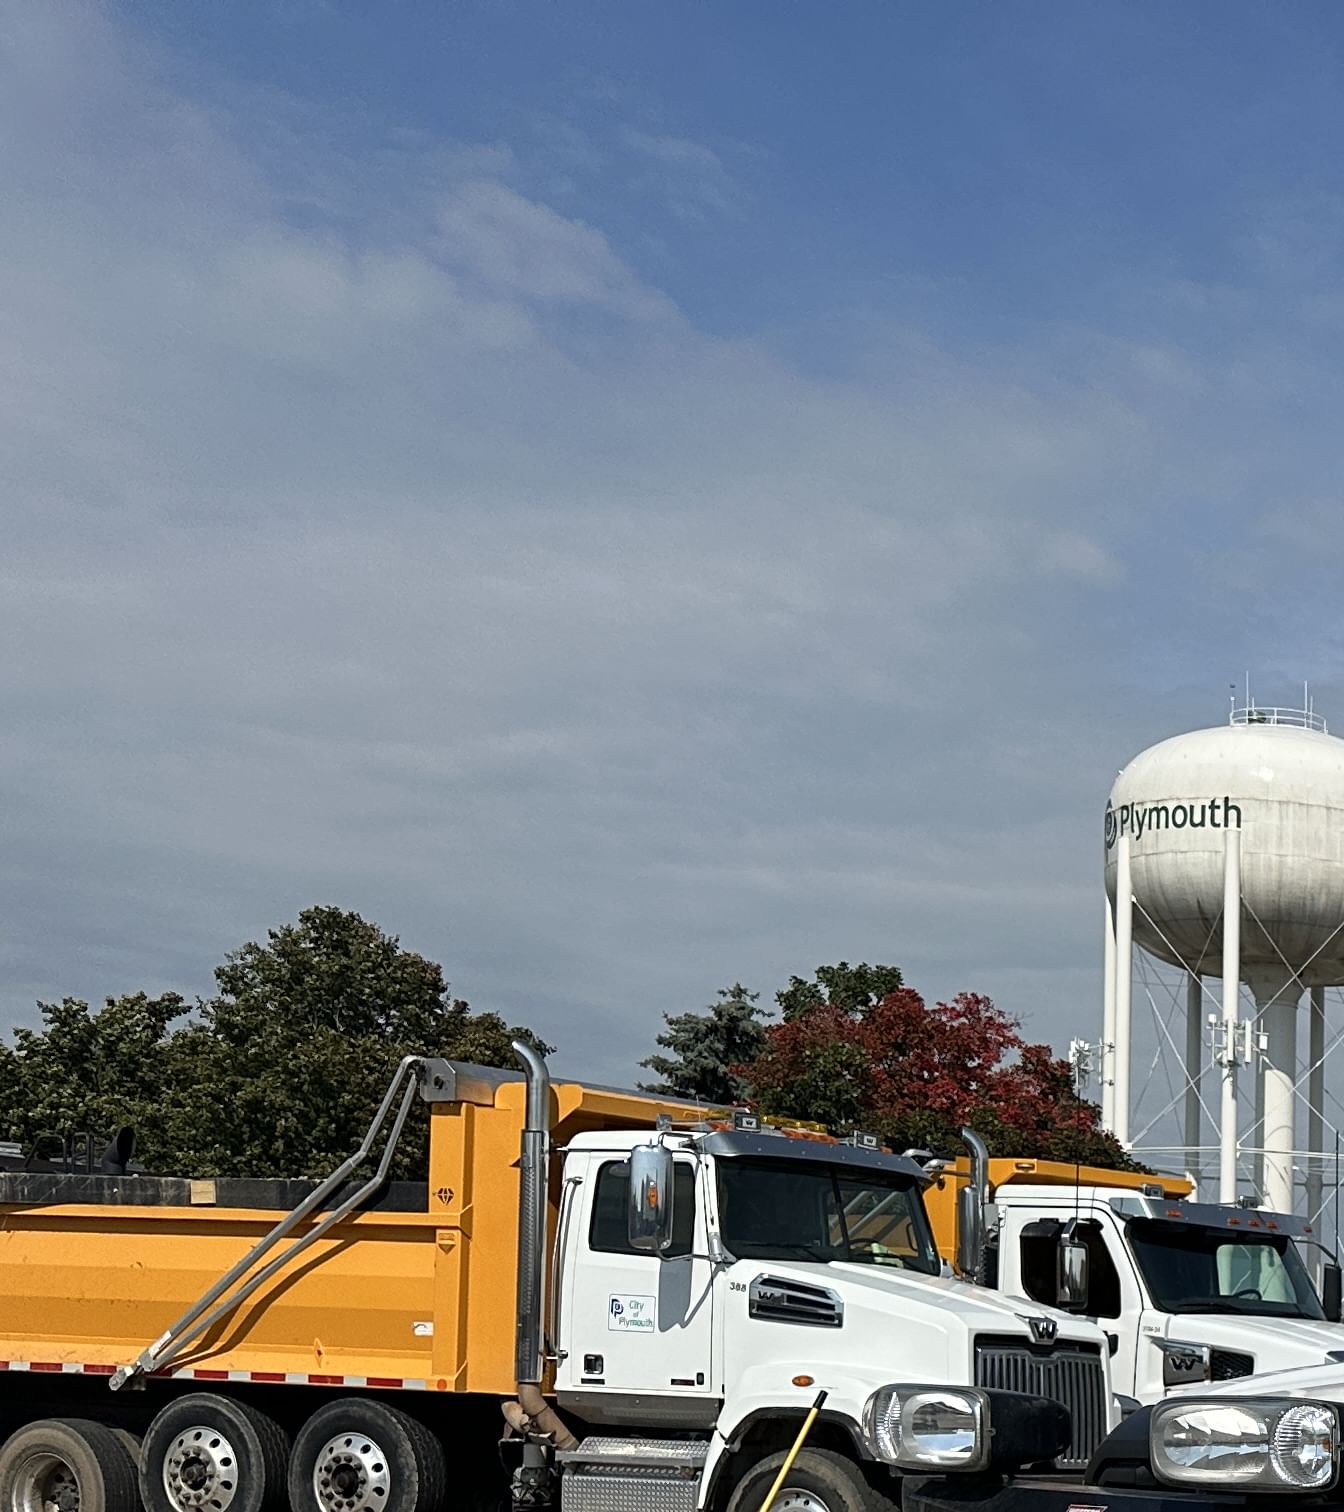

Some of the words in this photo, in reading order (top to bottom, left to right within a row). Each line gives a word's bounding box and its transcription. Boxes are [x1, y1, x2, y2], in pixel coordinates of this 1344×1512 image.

[1120, 796, 1242, 841] Plymouth
[629, 1300, 644, 1311] City
[618, 1316, 653, 1328] Plymouth
